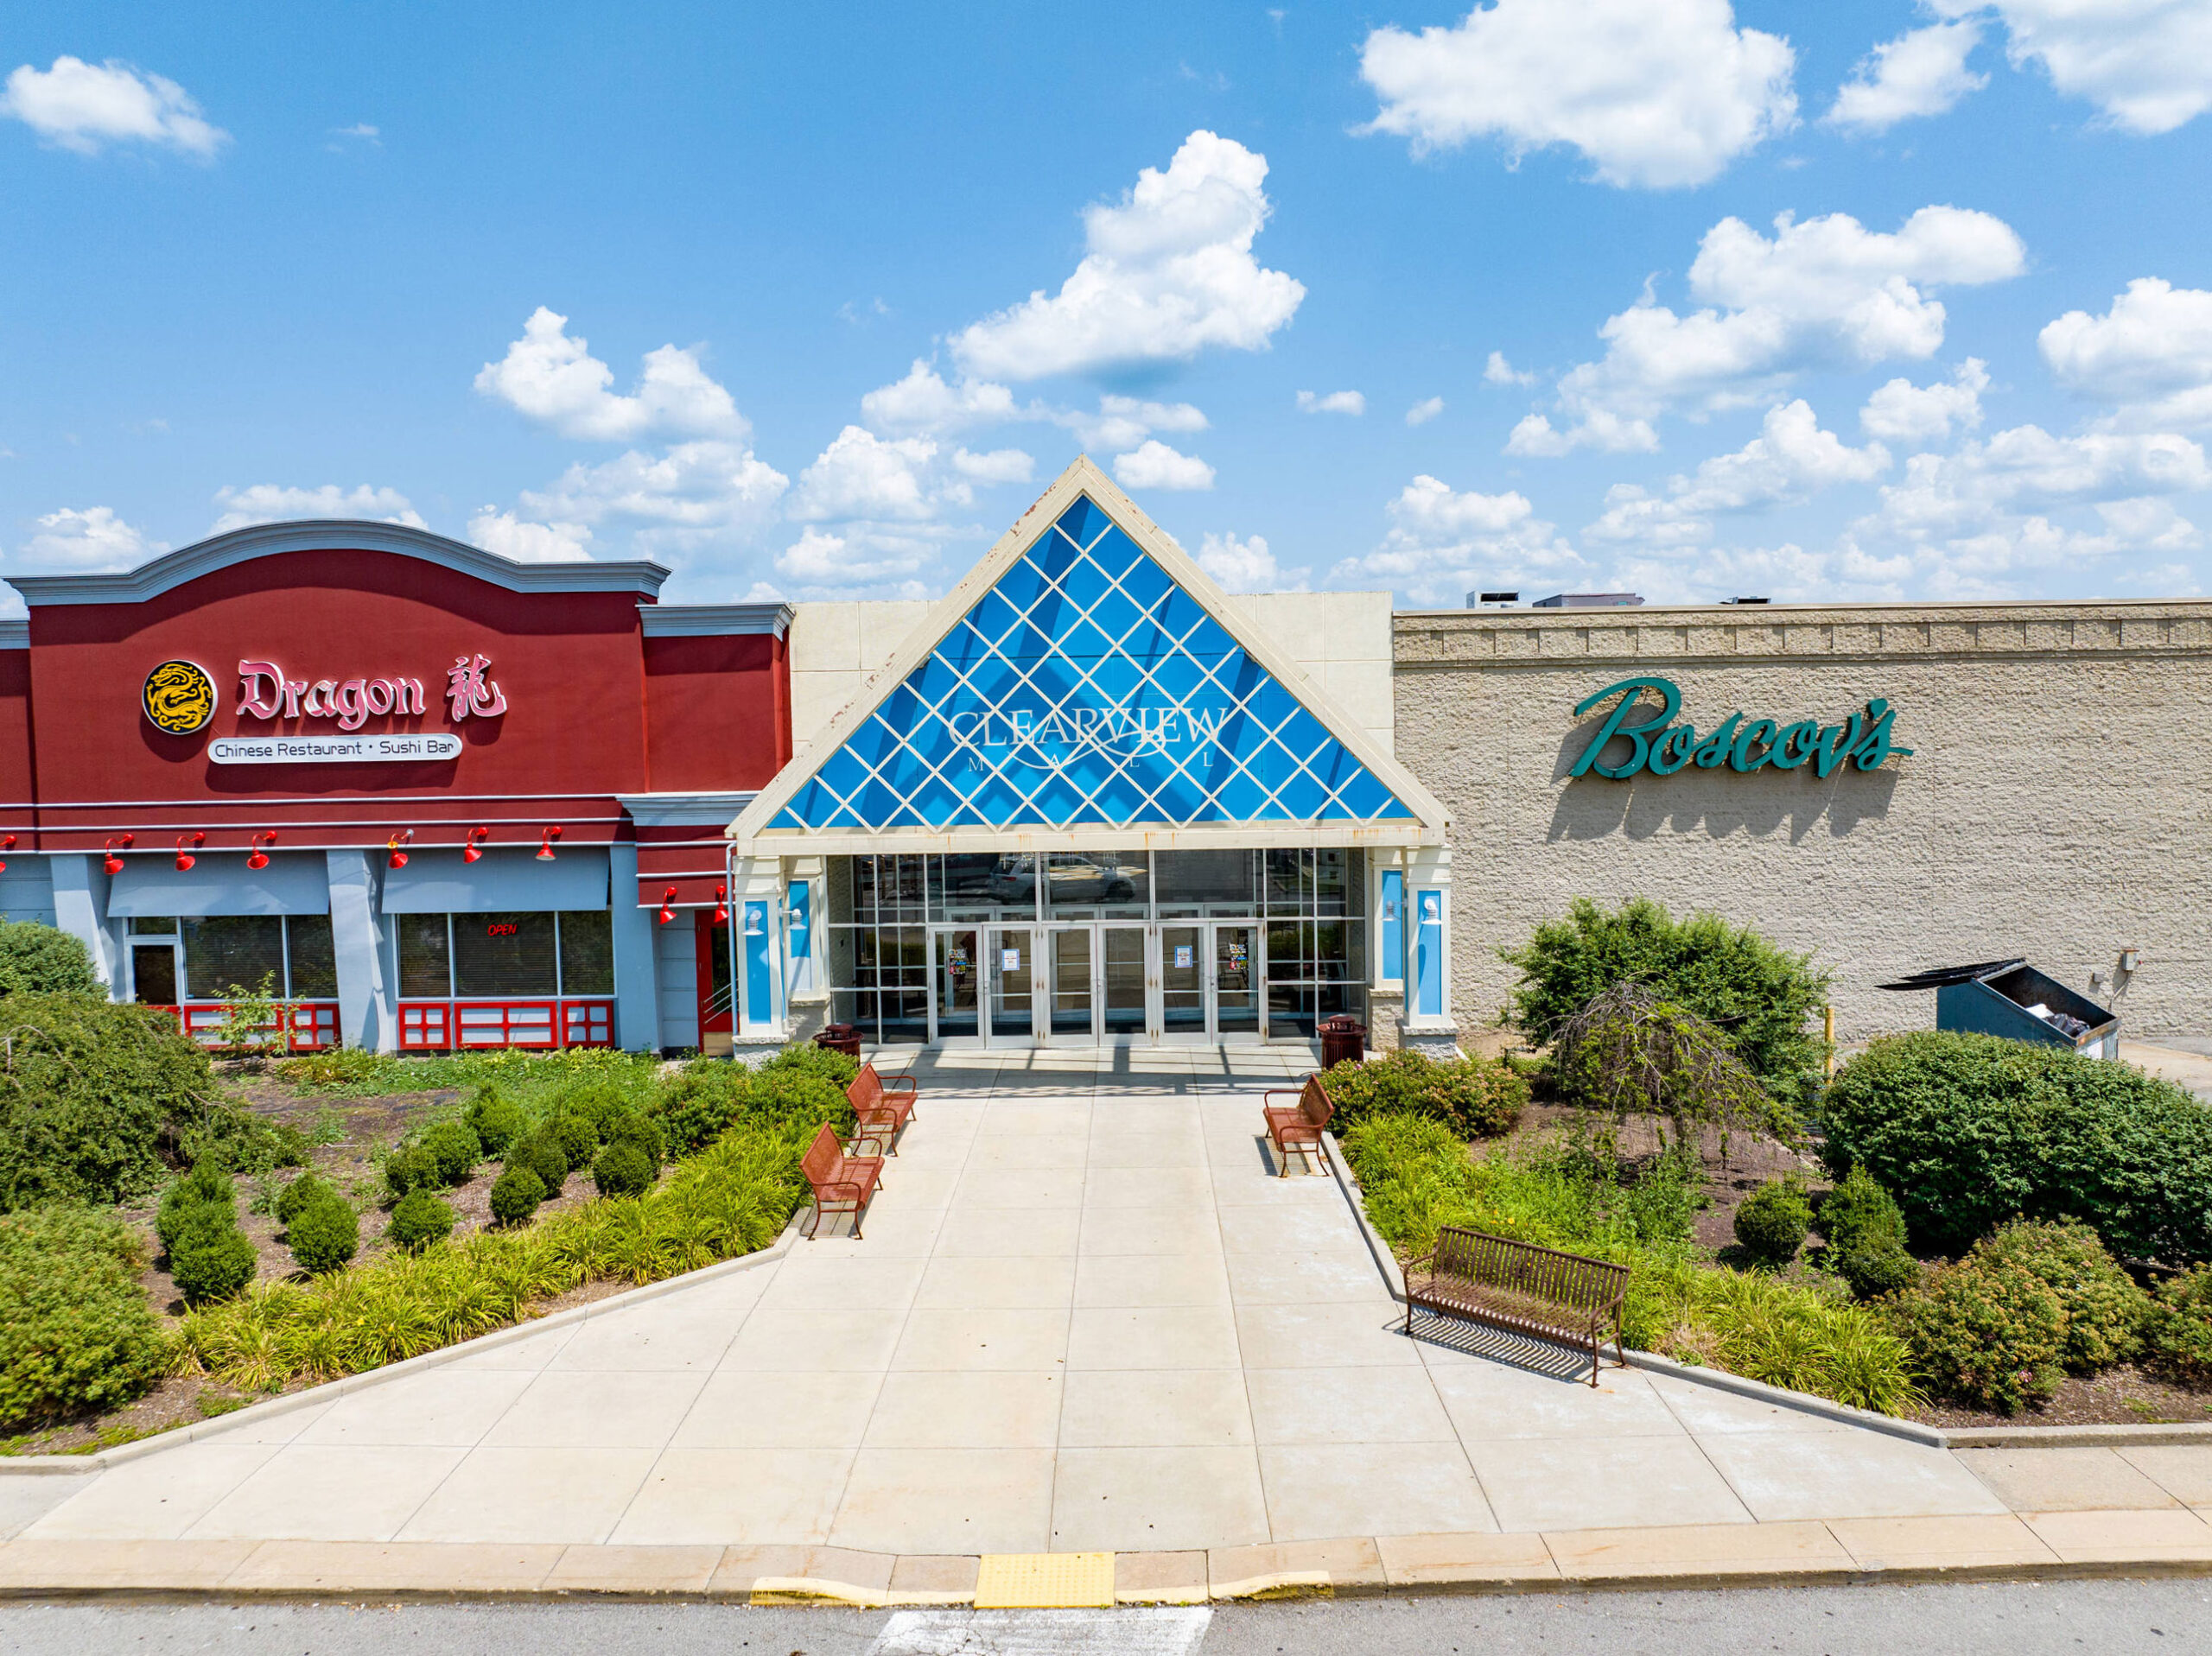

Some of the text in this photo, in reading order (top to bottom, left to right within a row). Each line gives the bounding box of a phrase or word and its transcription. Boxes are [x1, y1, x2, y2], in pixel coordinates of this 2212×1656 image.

[235, 659, 428, 731] Dragon
[447, 653, 509, 723] 龍
[214, 739, 454, 758] Chinese Restaurant Sushi Bar
[948, 707, 1229, 748] CLEARVIEW
[1568, 676, 1914, 778] Boscov's
[487, 923, 518, 936] OPEN
